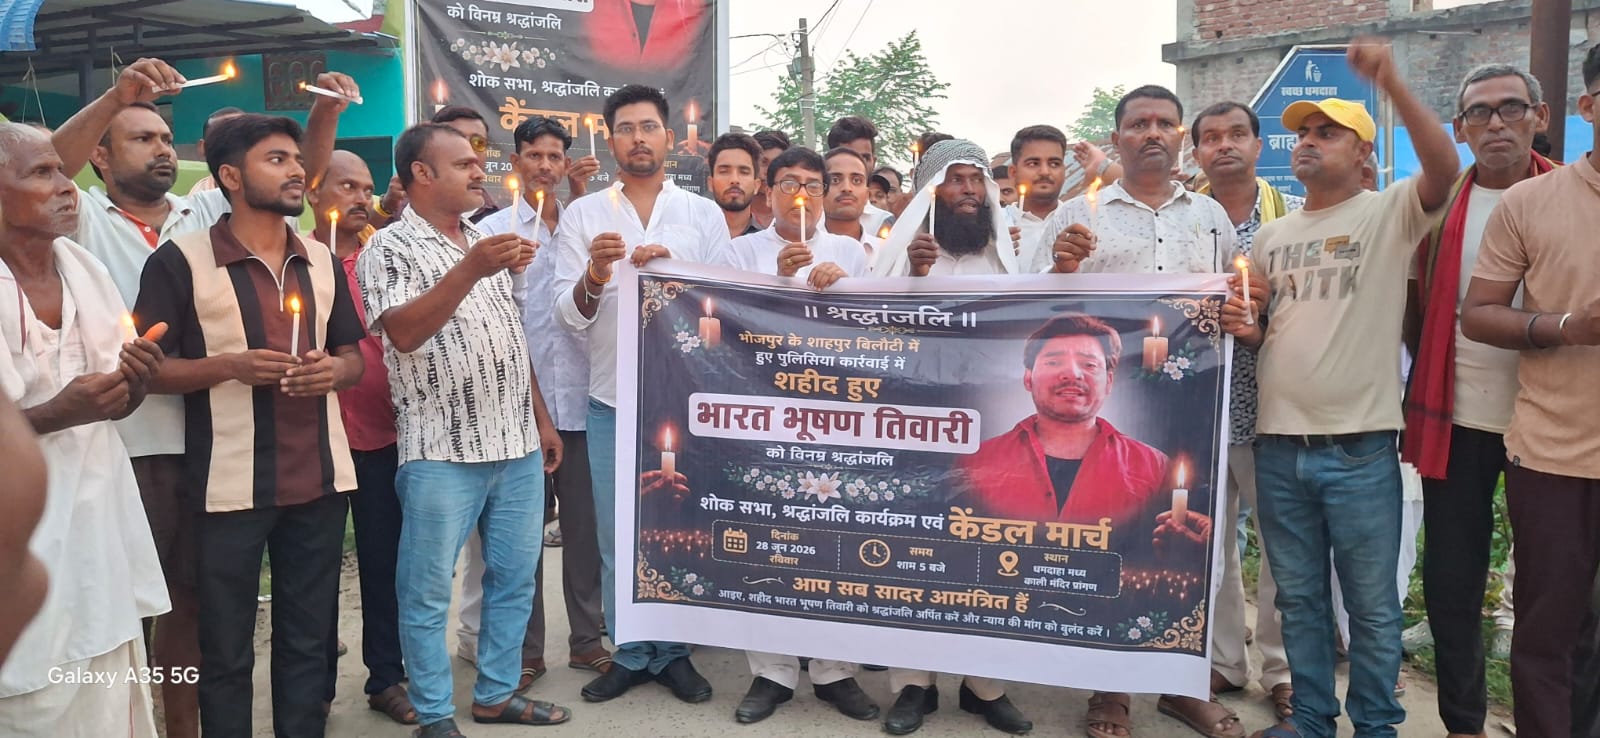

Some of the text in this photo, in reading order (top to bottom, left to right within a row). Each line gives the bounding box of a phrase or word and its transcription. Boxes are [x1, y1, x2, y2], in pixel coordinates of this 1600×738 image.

[447, 2, 562, 30] को विनम्र श्रद्धांजलि
[469, 70, 500, 89] शोक
[504, 77, 537, 95] सभा,
[541, 74, 600, 97] श्रद्धांजलि
[1268, 239, 1324, 273] THE
[827, 304, 953, 327] श्रद्धांजलि
[738, 331, 920, 353] भोजपुर के शाहपुर बिलौटी में
[755, 351, 905, 370] हुए पुलिसिया कार्रवाई में
[774, 368, 882, 401] शहीद हुए
[697, 402, 973, 444] भारत भूषण तिवारी
[765, 445, 894, 466] को विनम्र श्रद्धांजलि
[699, 495, 1112, 550] शोक सभा, श्रद्धांजलि कार्यक्रम एवं केंडल मार्च
[771, 528, 800, 541] दिनांक
[755, 541, 816, 555] 28 जून 2026
[909, 546, 934, 557] समय
[1043, 553, 1069, 564] स्थान
[769, 554, 799, 566] रविवार
[896, 560, 947, 573] शाम 5 बजे
[1033, 565, 1087, 577] धमदाहा मध्य
[1024, 577, 1047, 587] काली
[1050, 578, 1070, 589] मंदिर
[792, 576, 1030, 612] आप सब सादर आमंत्रित हैं
[718, 589, 745, 601] आइए,
[748, 592, 772, 604] शहीद
[775, 596, 796, 606] भारत
[800, 599, 823, 611] भूषण
[826, 599, 853, 612] तिवारी
[856, 602, 869, 614] को
[871, 604, 912, 618] श्रद्धांजलि
[916, 609, 941, 621] अर्पित
[945, 611, 959, 622] करें
[963, 612, 979, 624] और
[983, 616, 1004, 627] न्याय
[1008, 615, 1021, 628] की
[1024, 618, 1041, 631] मांग
[1045, 620, 1057, 632] को
[1060, 623, 1083, 636] बुलंद
[1087, 625, 1103, 637] करें
